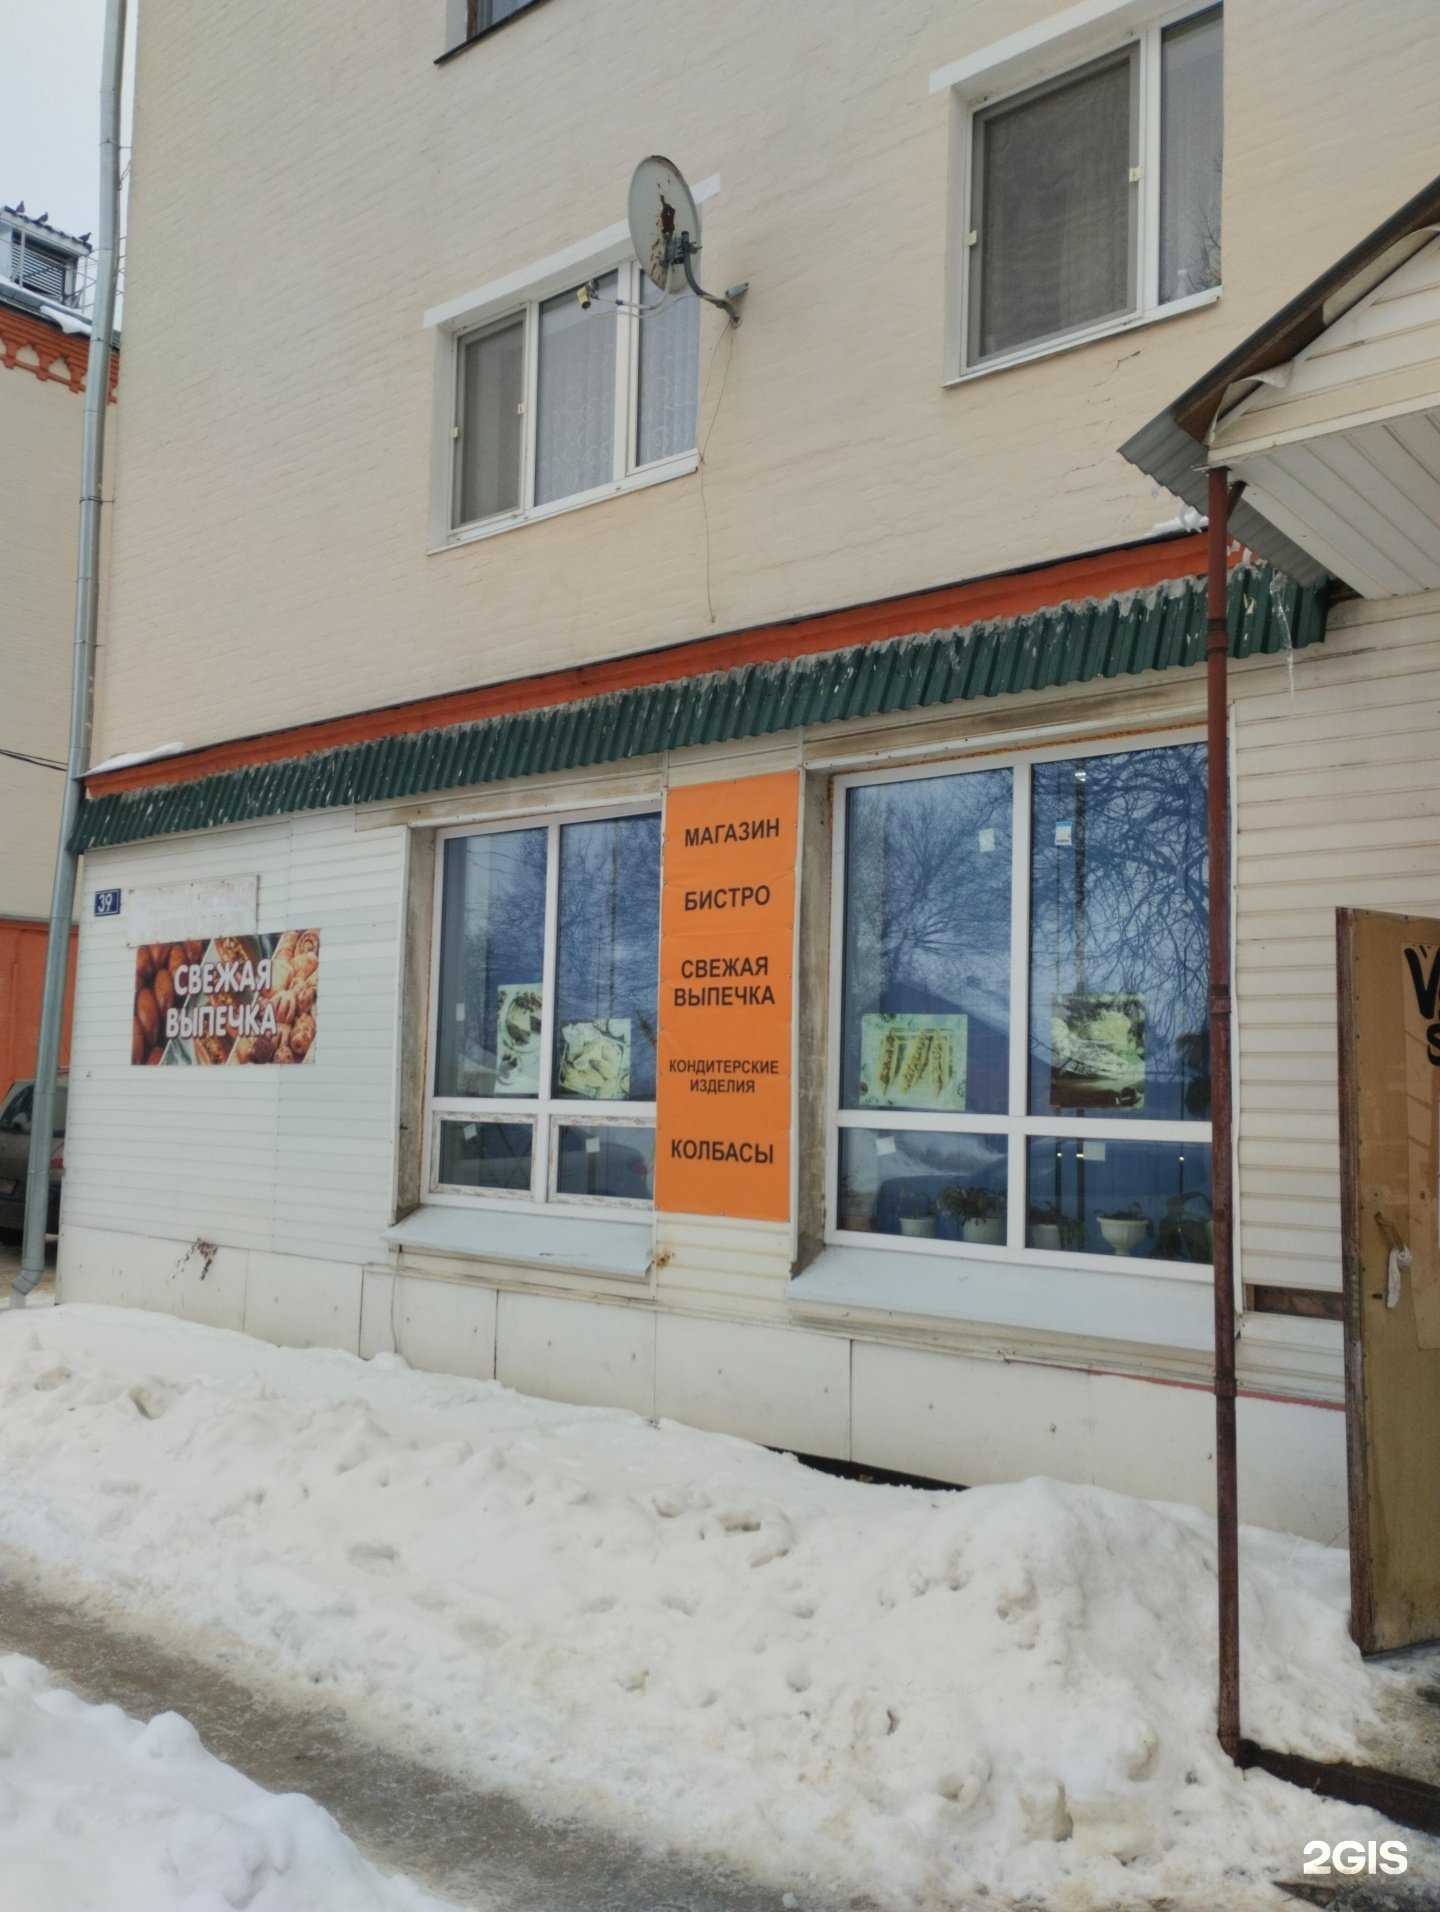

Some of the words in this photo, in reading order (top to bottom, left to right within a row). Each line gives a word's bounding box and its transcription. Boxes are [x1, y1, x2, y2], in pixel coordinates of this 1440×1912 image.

[684, 818, 780, 848] МАГАЗИН
[97, 893, 112, 913] 39
[684, 884, 771, 912] БИСТРО
[173, 958, 273, 996] СВЕЖАЯ
[680, 955, 769, 980] СВЕЖАЯ
[673, 985, 776, 1008] ВЫПЕЧКА
[165, 1003, 278, 1039] ВЫПЕЧКА
[669, 1058, 779, 1076] КОНДИТЕРСКИЕ
[689, 1078, 756, 1095] ИЗДЕЛИЯ
[671, 1138, 774, 1166] КОЛБАСЫ
